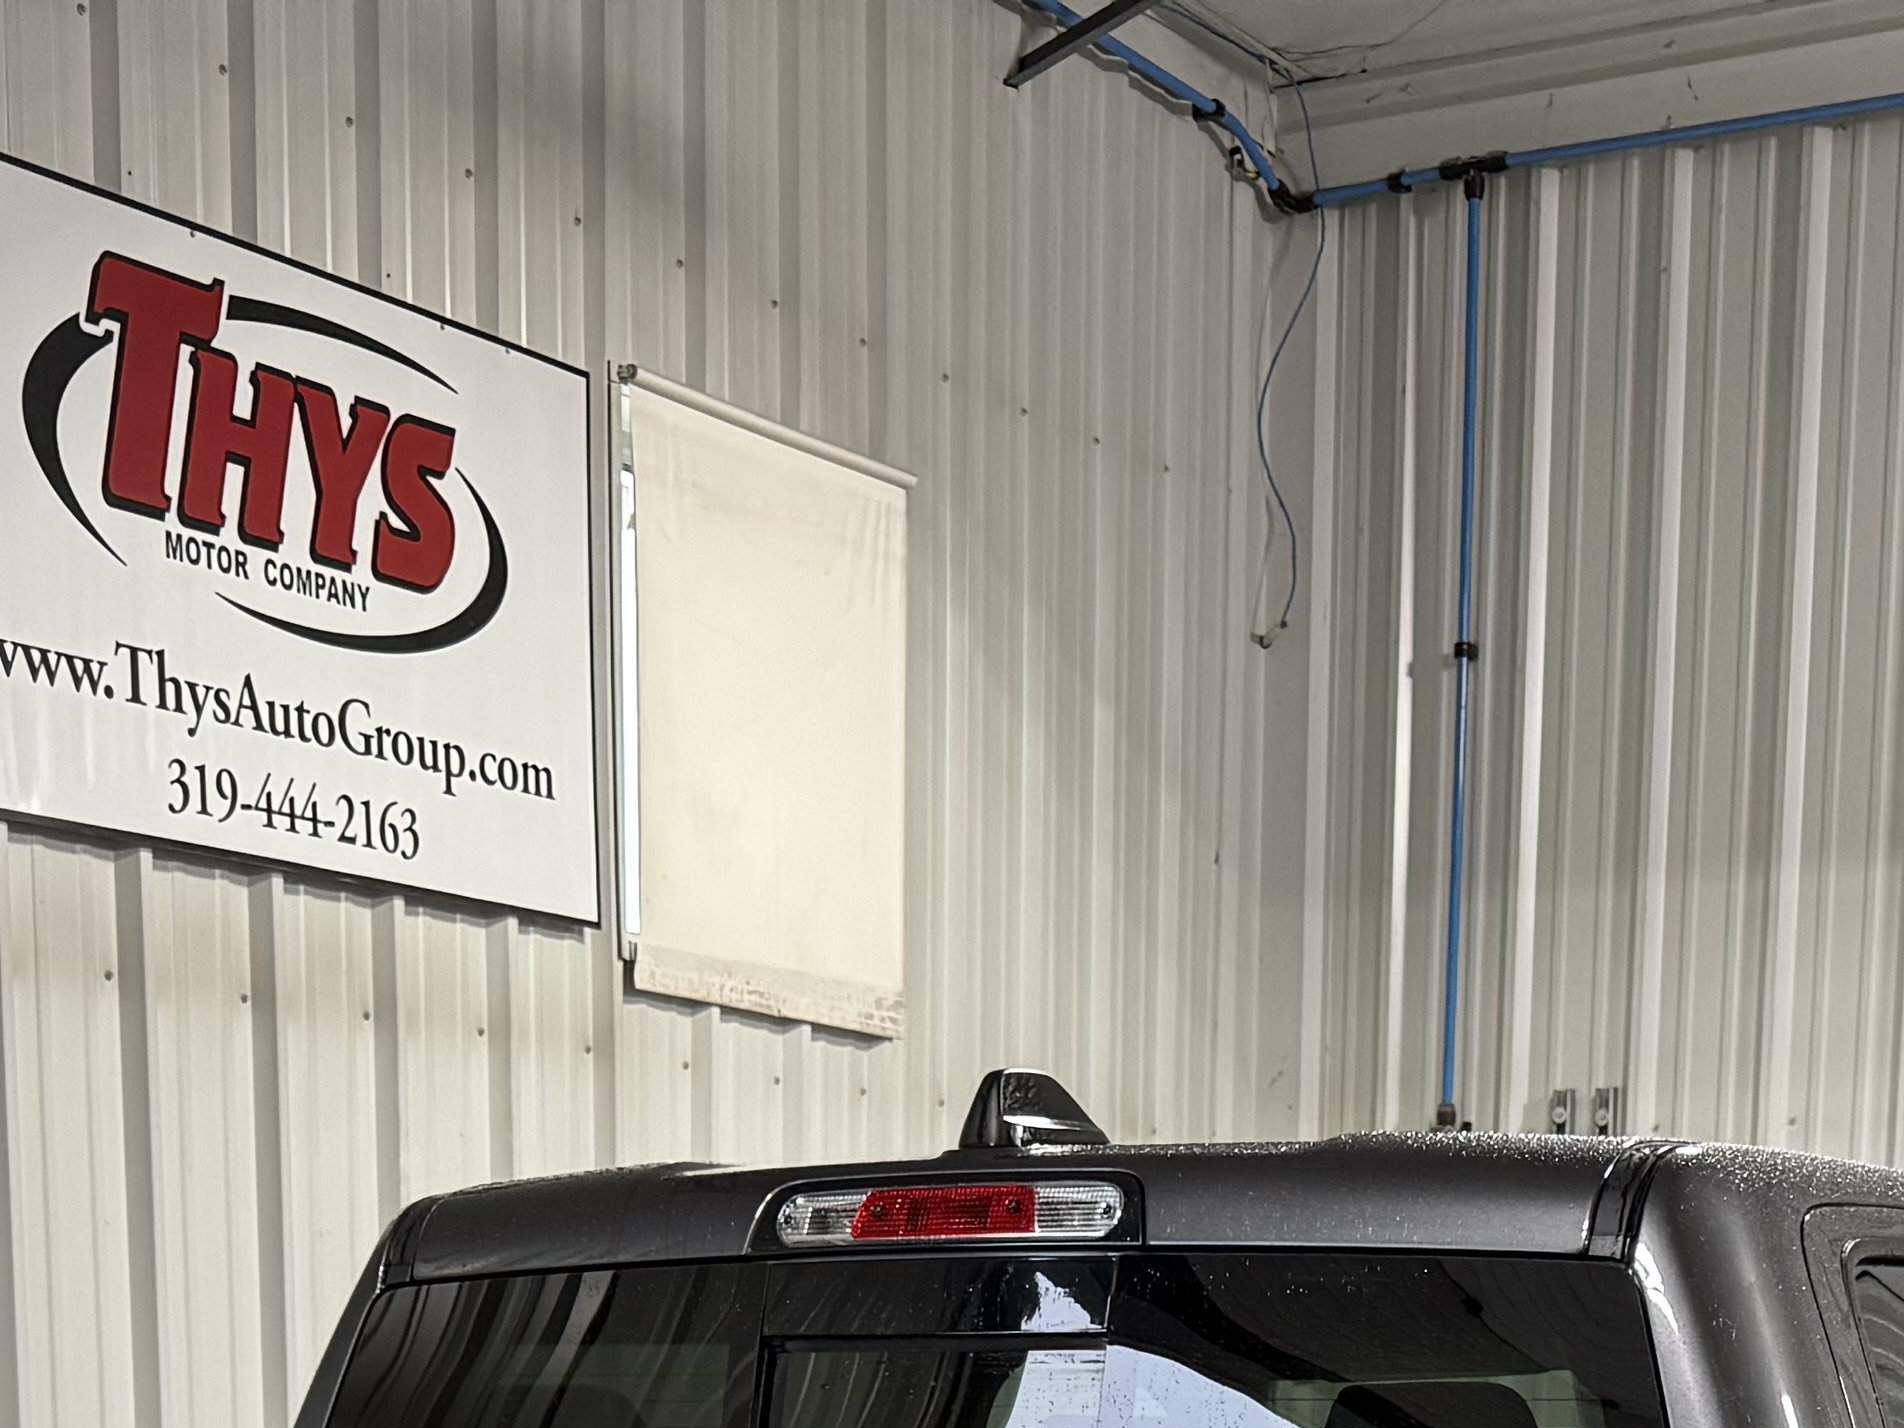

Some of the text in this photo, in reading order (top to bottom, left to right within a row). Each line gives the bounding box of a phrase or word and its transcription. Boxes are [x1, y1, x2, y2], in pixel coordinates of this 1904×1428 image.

[86, 251, 456, 595] THYS
[165, 531, 371, 613] MOTOR COMPANY
[167, 758, 421, 861] 319-444-2163
